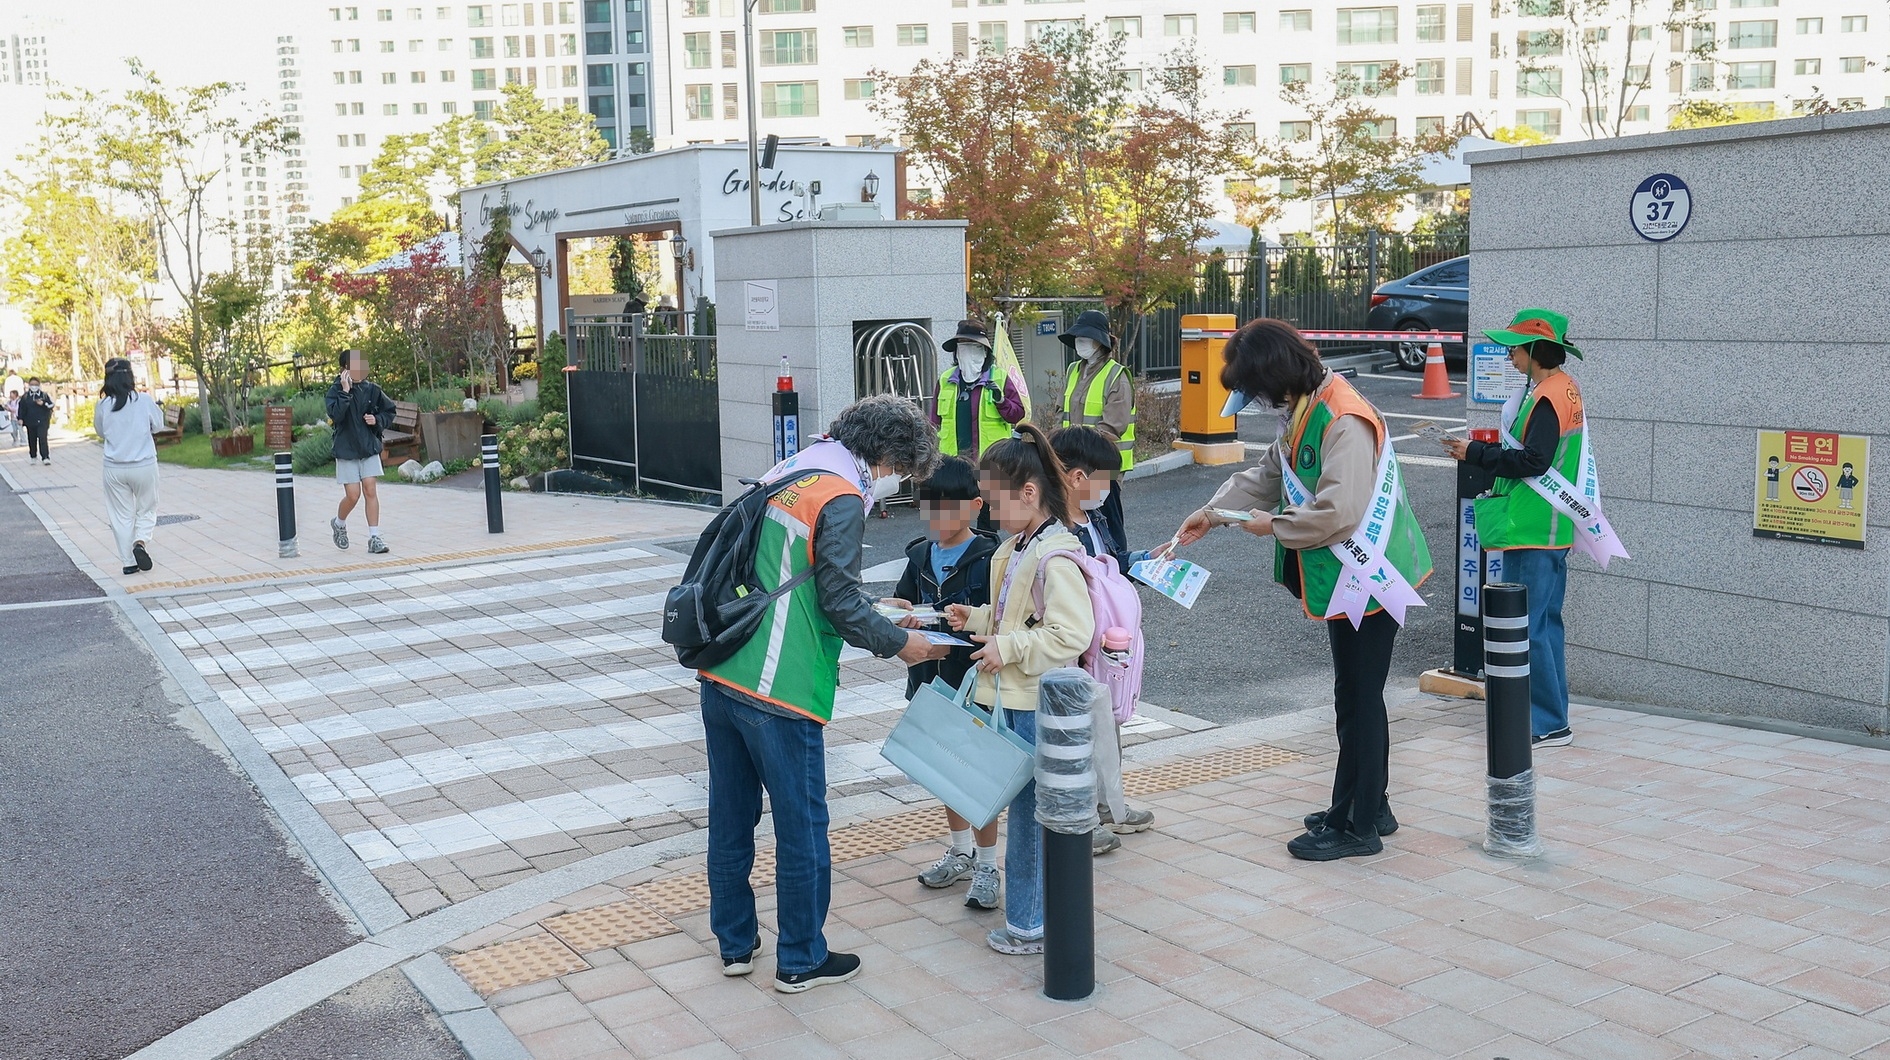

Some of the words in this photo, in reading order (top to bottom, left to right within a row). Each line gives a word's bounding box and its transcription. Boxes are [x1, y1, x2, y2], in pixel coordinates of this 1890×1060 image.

[524, 199, 560, 233] Scape
[650, 208, 679, 221] Greatness
[1646, 201, 1675, 221] 37
[1538, 473, 1562, 496] 먼저
[1462, 505, 1478, 606] 출차주의
